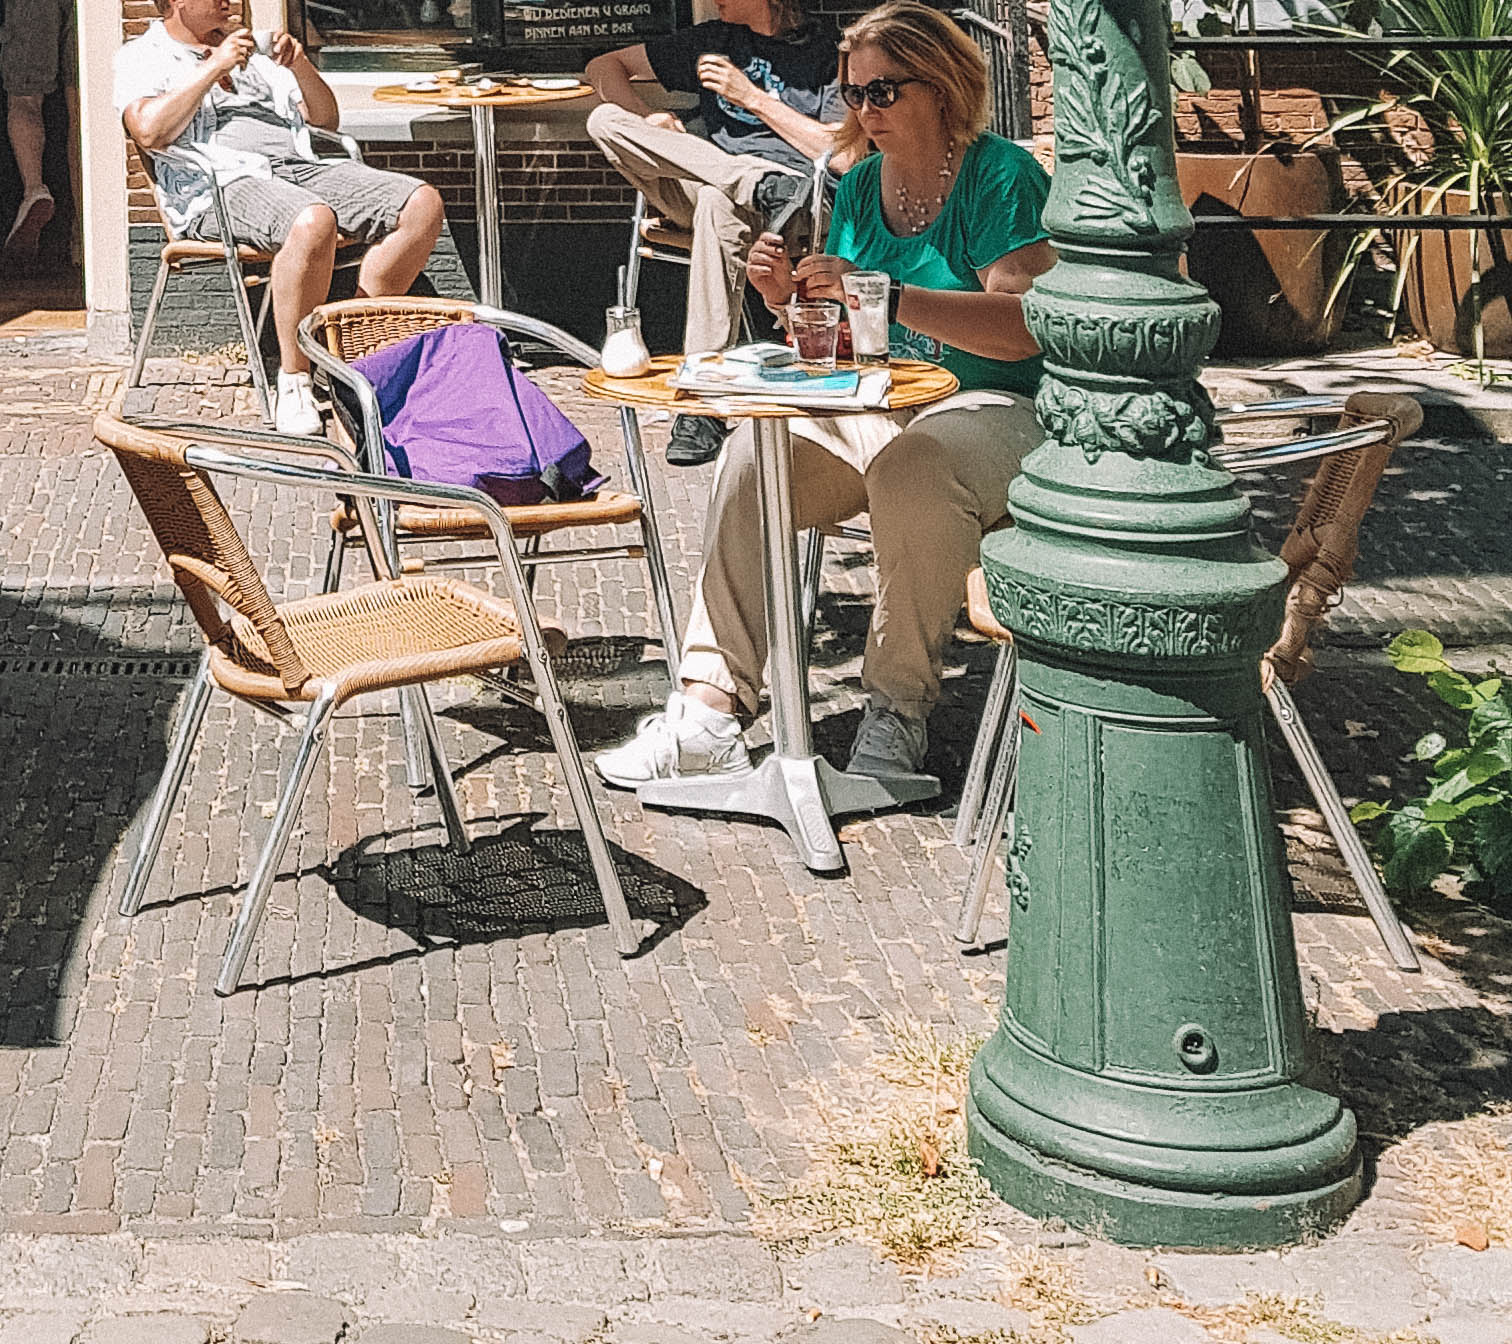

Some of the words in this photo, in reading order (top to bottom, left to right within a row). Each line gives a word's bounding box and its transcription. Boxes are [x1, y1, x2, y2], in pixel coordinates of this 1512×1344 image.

[602, 4, 612, 17] U
[568, 24, 591, 37] AAN
[611, 22, 634, 34] BAR
